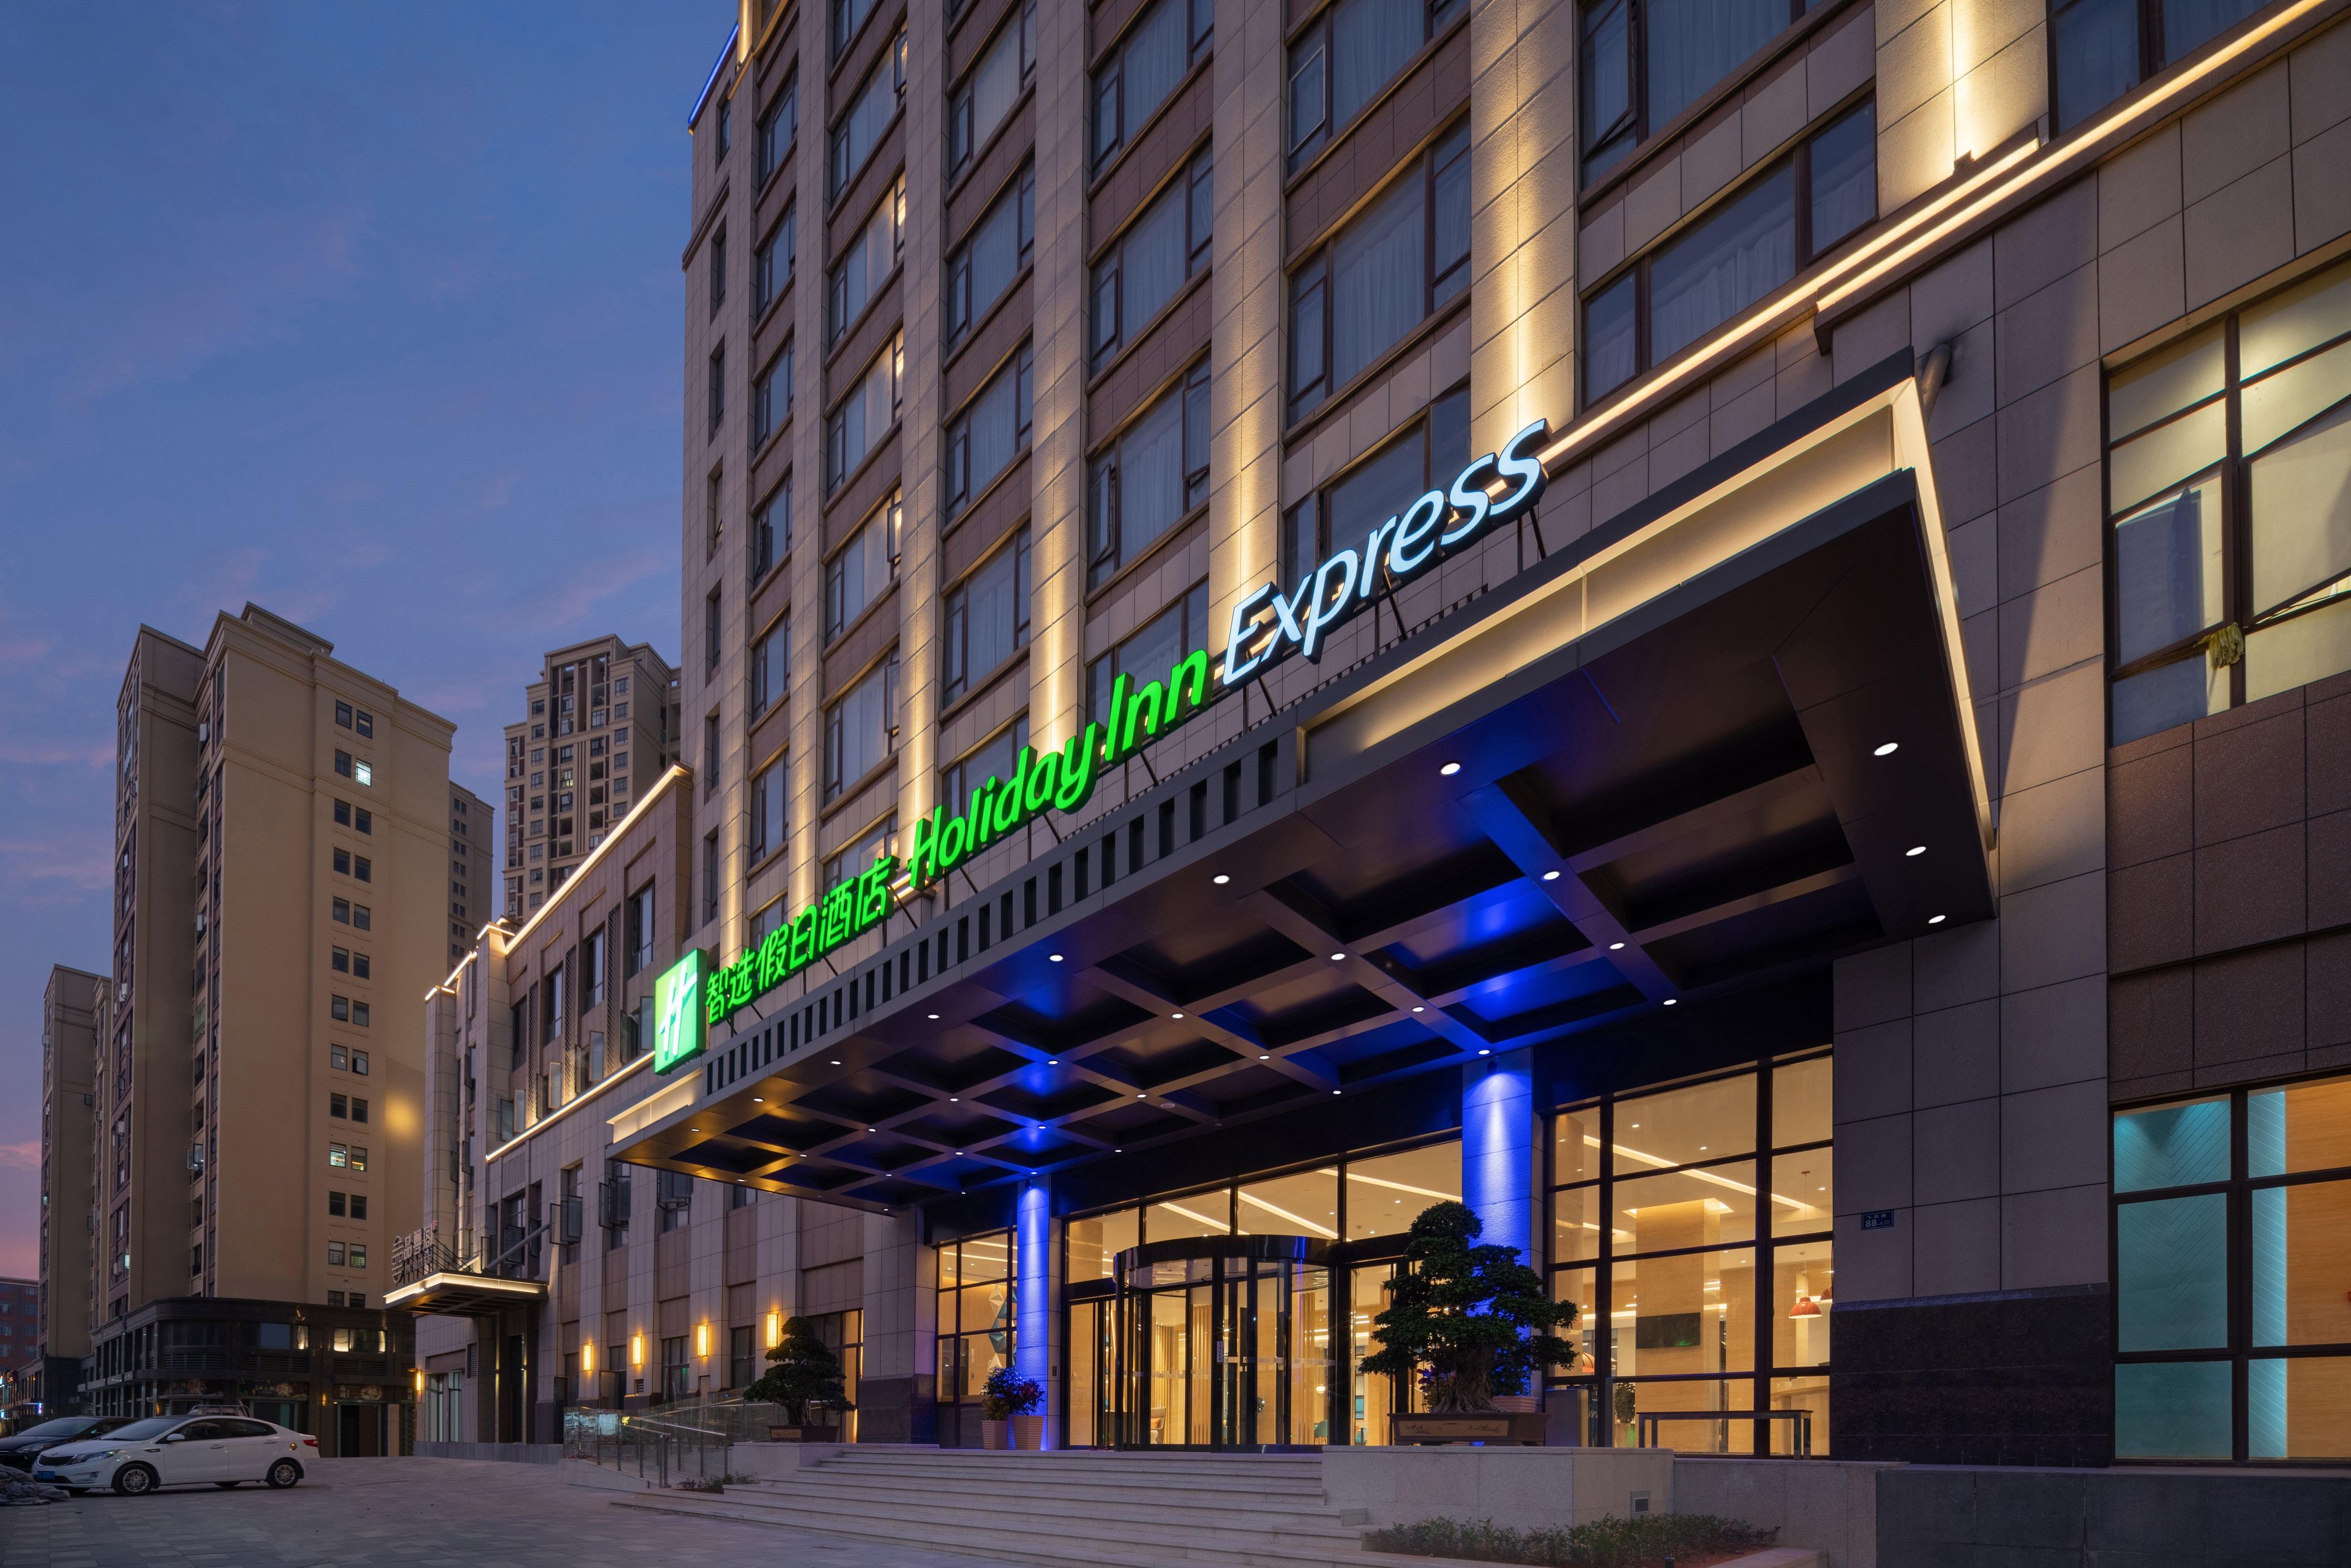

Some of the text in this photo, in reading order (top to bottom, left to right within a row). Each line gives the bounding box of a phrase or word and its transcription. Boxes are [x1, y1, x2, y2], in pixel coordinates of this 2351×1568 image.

[906, 419, 1545, 888] Holiday Inn Express
[705, 855, 893, 1024] 智选假日酒店
